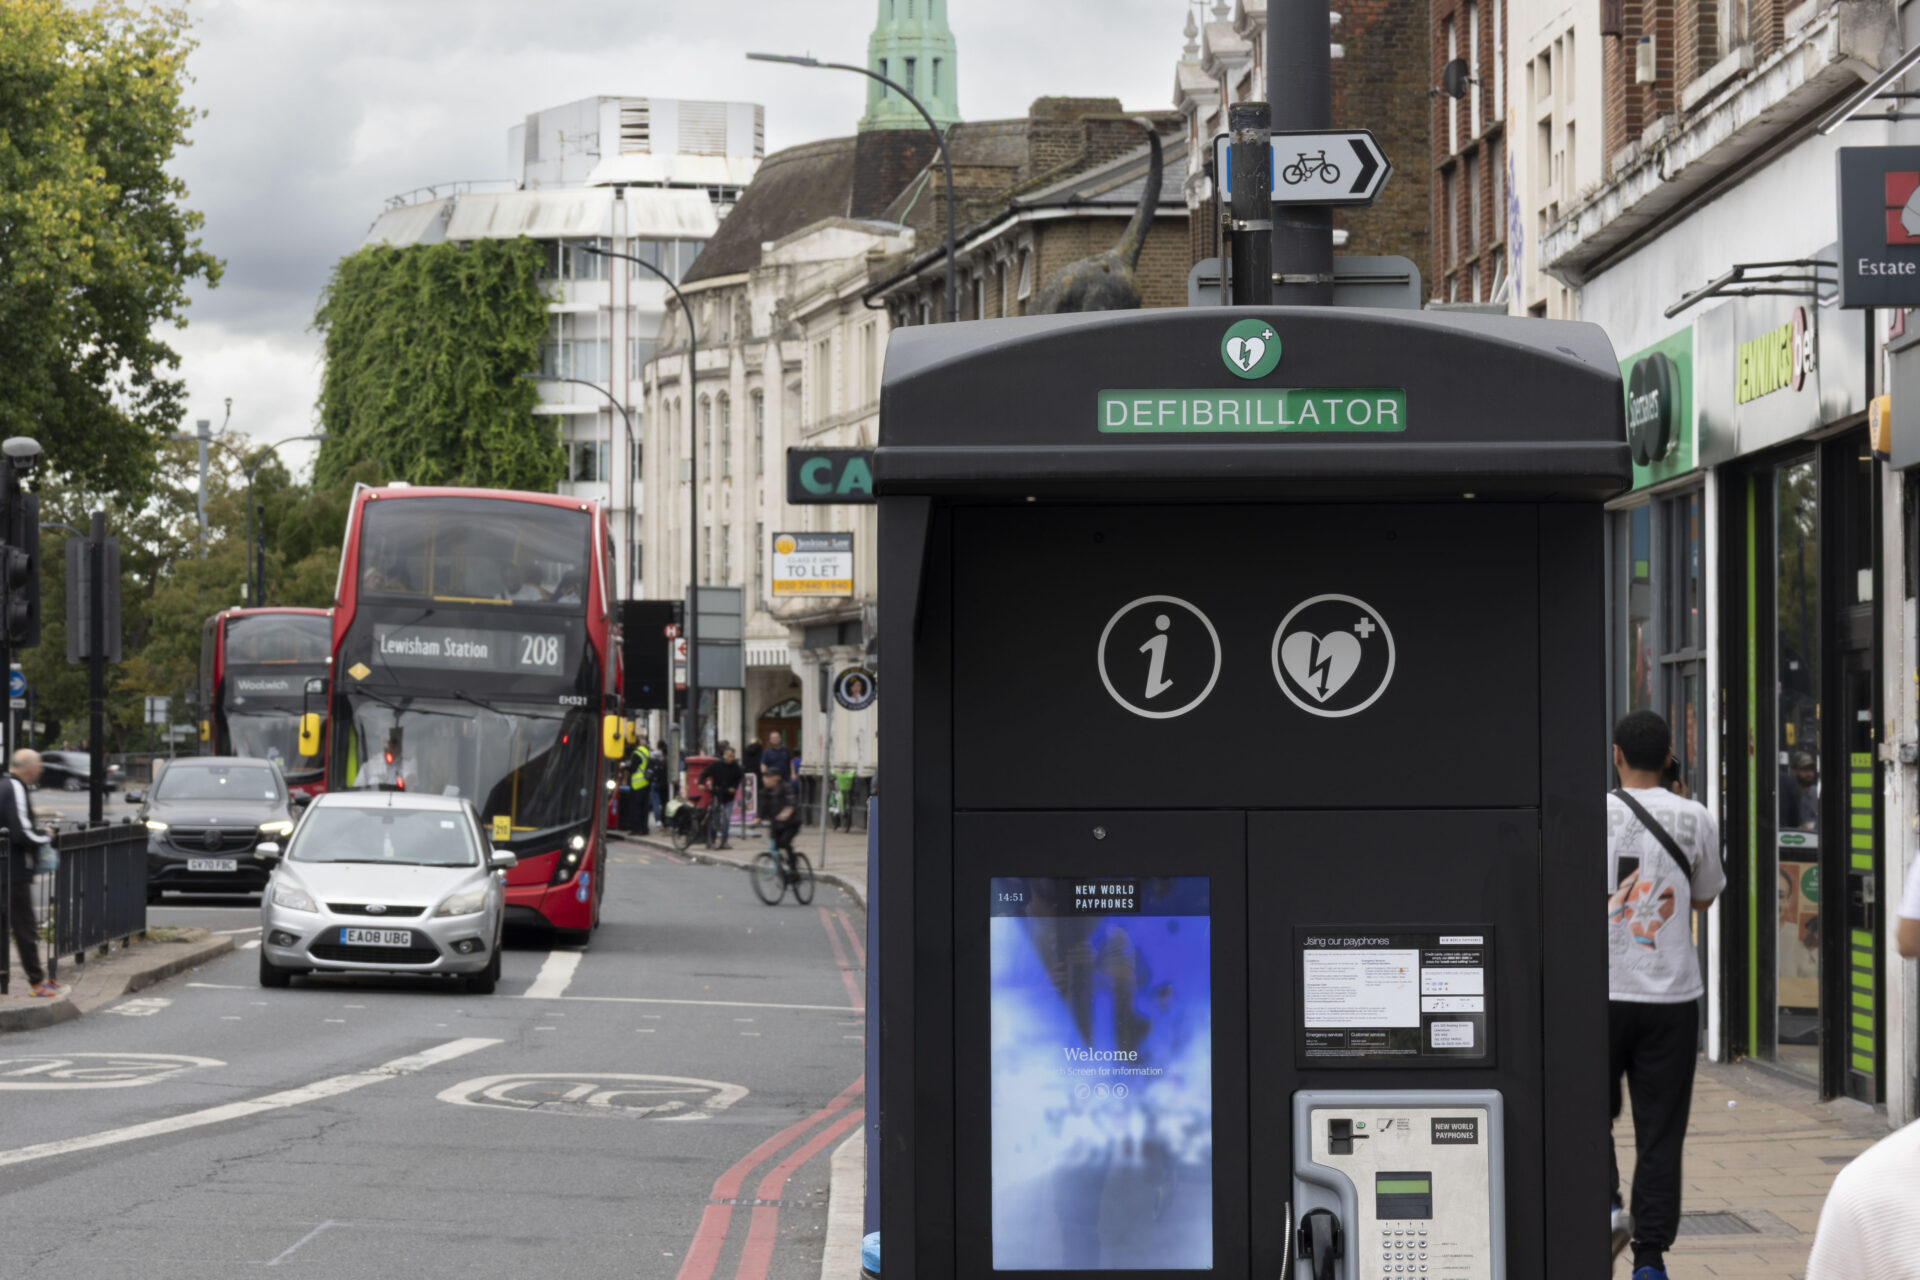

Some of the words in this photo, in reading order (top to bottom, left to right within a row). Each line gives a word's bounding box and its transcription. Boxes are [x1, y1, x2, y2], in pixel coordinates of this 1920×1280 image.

[1858, 258, 1916, 276] Estate
[1105, 398, 1399, 427] DEFIBRILLATOR
[785, 564, 807, 578] TO
[812, 564, 840, 578] LET
[380, 634, 440, 656] Lewisham
[444, 637, 488, 659] Station
[521, 635, 559, 665] 208
[1075, 884, 1096, 895] NEW
[1100, 884, 1135, 895] WORLD
[998, 892, 1024, 902] 14:51
[1075, 898, 1135, 910] PAYPHONES
[348, 930, 381, 943] EA08
[384, 931, 409, 945] UBG
[1327, 938, 1342, 946] our
[1343, 936, 1390, 948] payphones
[1063, 1046, 1138, 1062] Welcome
[1067, 1065, 1096, 1076] Screen
[1097, 1065, 1111, 1076] for
[1112, 1065, 1163, 1076] information
